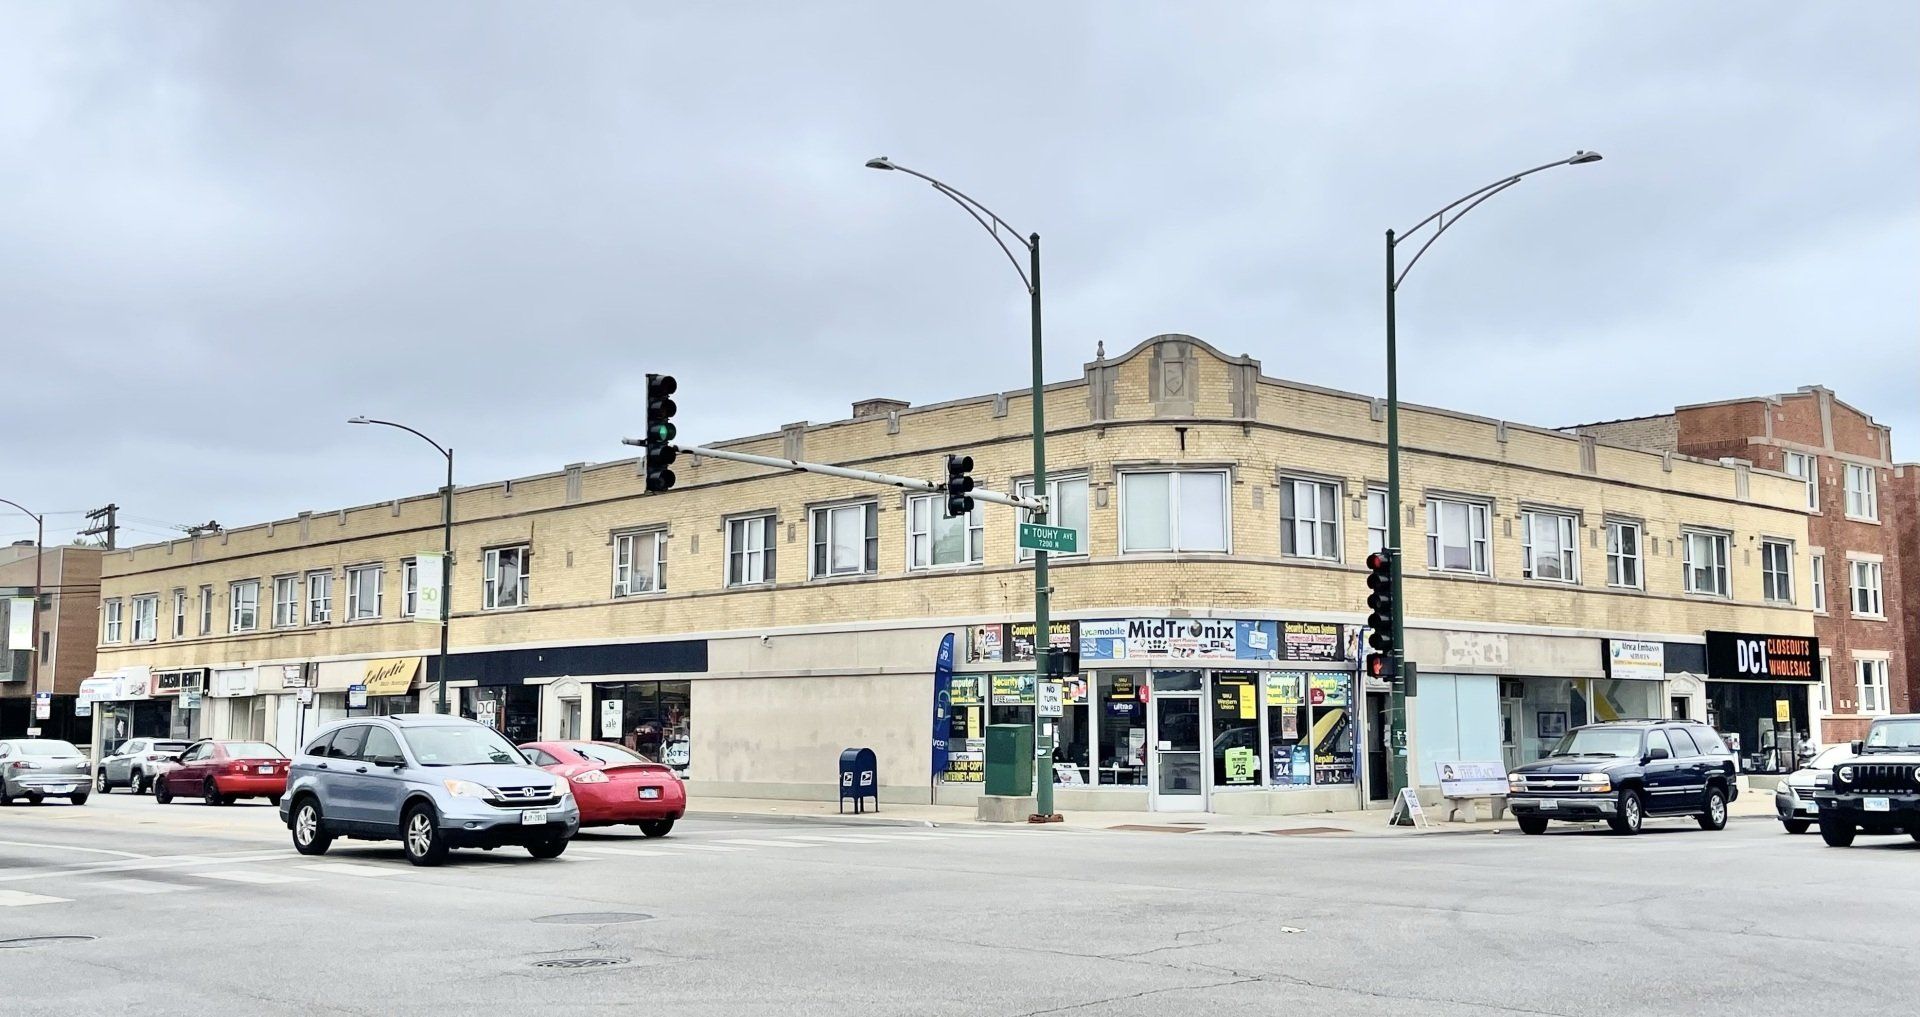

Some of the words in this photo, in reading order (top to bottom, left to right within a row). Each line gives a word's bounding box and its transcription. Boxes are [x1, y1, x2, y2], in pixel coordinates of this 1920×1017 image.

[1032, 527, 1058, 540] TOUHY
[1038, 539, 1053, 548] 7200
[421, 586, 438, 602] 50
[1011, 624, 1036, 637] Comput
[1080, 626, 1125, 637] Lycamobile
[1128, 619, 1234, 639] MidTronix
[1285, 622, 1303, 635] Security
[1303, 622, 1321, 634] Camera
[1737, 639, 1768, 674] DCI
[1767, 638, 1809, 656] CLOSEOUTS
[1769, 659, 1811, 677] WHOLESALE
[993, 674, 1018, 689] Security
[1044, 695, 1057, 703] TURN
[1217, 698, 1238, 706] Western
[477, 700, 495, 715] DCI
[1314, 754, 1335, 766] Repair
